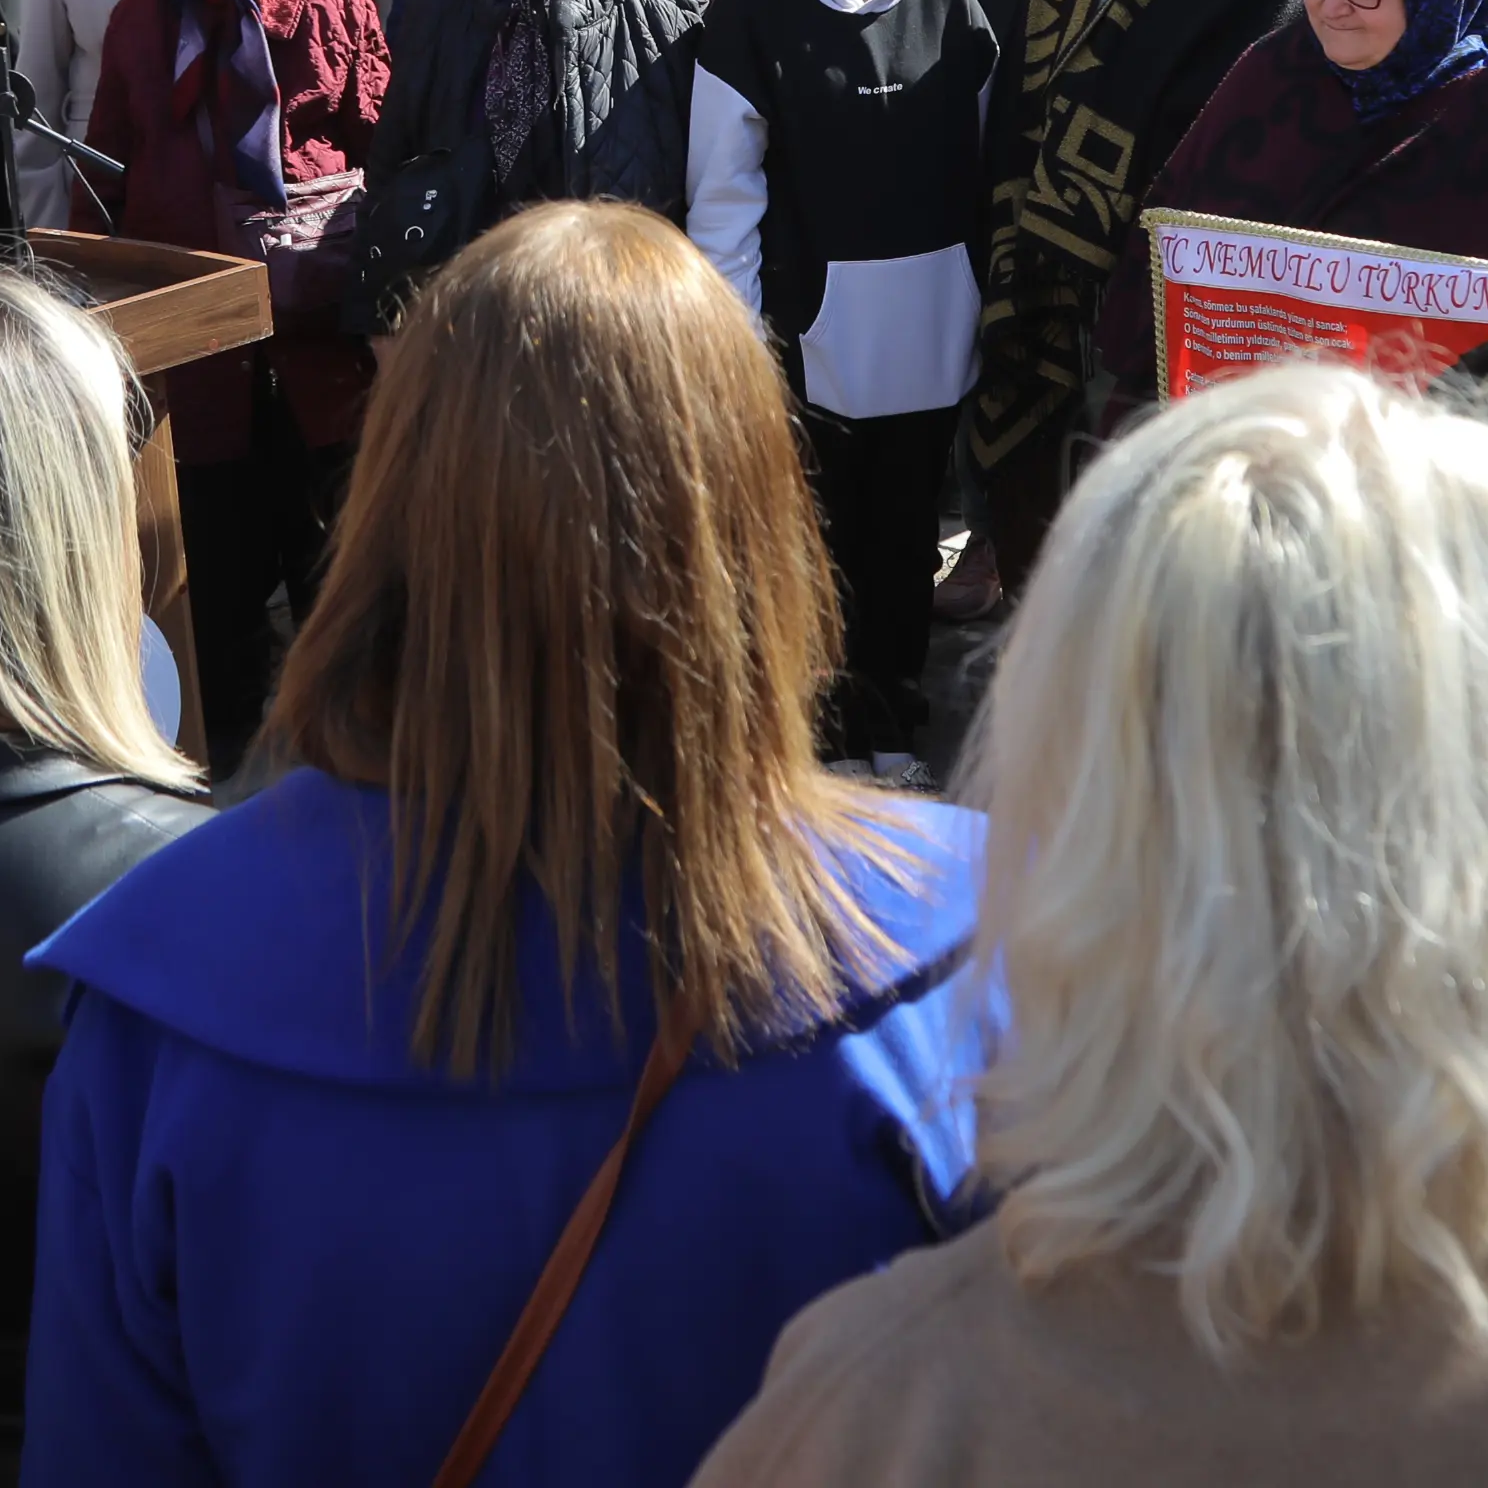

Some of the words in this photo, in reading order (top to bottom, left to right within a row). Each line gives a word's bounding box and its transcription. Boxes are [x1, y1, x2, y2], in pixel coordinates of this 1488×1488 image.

[857, 86, 872, 95] We
[873, 82, 903, 94] create
[1161, 233, 1189, 274] TC
[1193, 240, 1351, 294] NEMUTLU
[1203, 299, 1235, 313] sönmez
[1235, 302, 1248, 313] bu
[1184, 323, 1191, 334] O
[1211, 317, 1256, 330] yurdumun
[1184, 338, 1192, 349] O
[1223, 349, 1252, 361] benim
